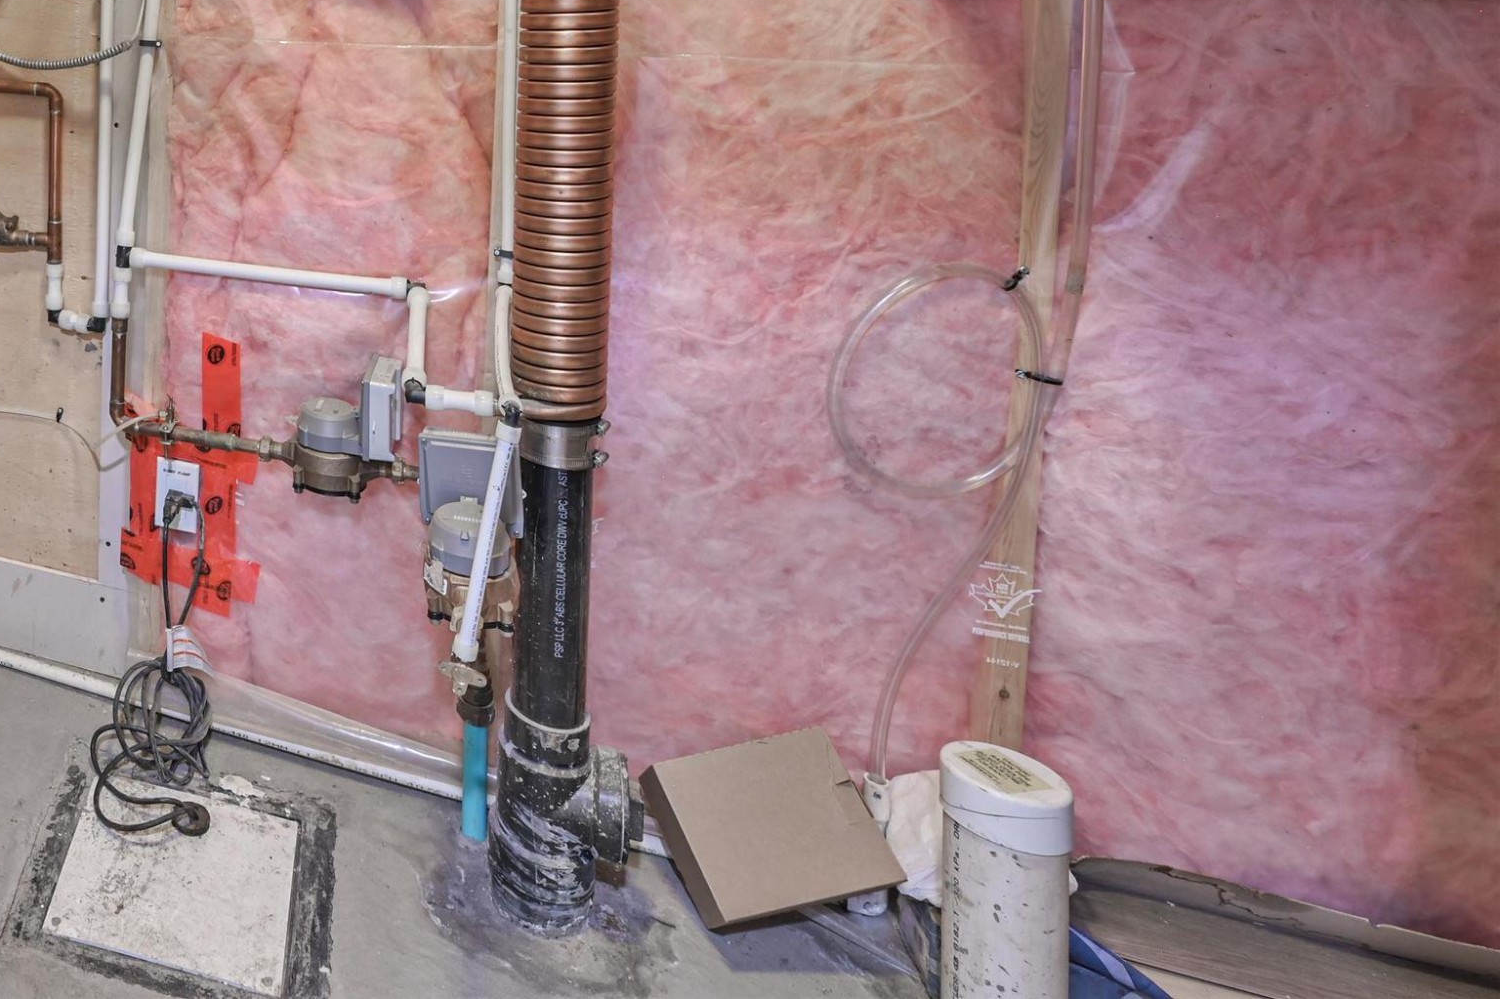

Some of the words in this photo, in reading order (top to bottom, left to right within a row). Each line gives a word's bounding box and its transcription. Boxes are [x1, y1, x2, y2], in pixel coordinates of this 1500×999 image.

[556, 539, 567, 561] CORE
[555, 561, 567, 601] CELLULAR
[555, 601, 565, 617] ABS
